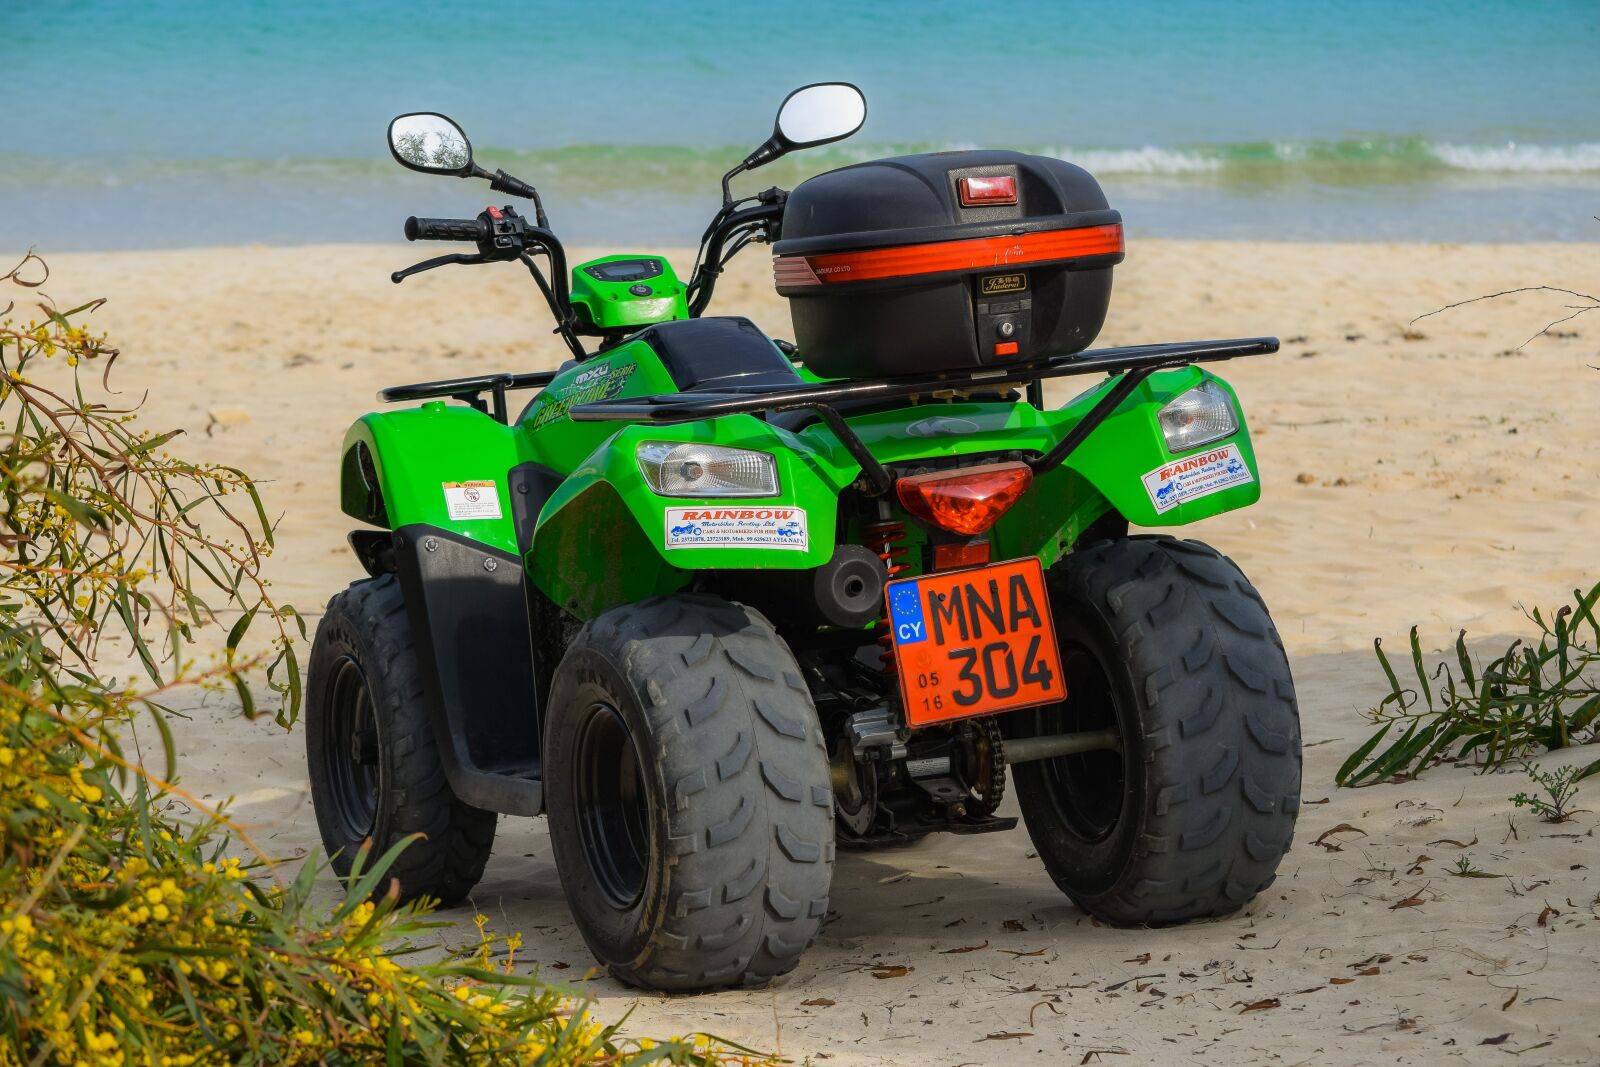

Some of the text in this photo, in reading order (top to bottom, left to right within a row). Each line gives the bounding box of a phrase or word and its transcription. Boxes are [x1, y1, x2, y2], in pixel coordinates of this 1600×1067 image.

[576, 364, 609, 384] MXU
[1160, 450, 1229, 481] RAINBOW
[682, 510, 795, 520] RAINBOW
[928, 574, 1042, 645] MNA
[899, 621, 922, 640] CY
[918, 672, 940, 688] 05
[948, 635, 1053, 706] 304
[923, 696, 943, 711] 16
